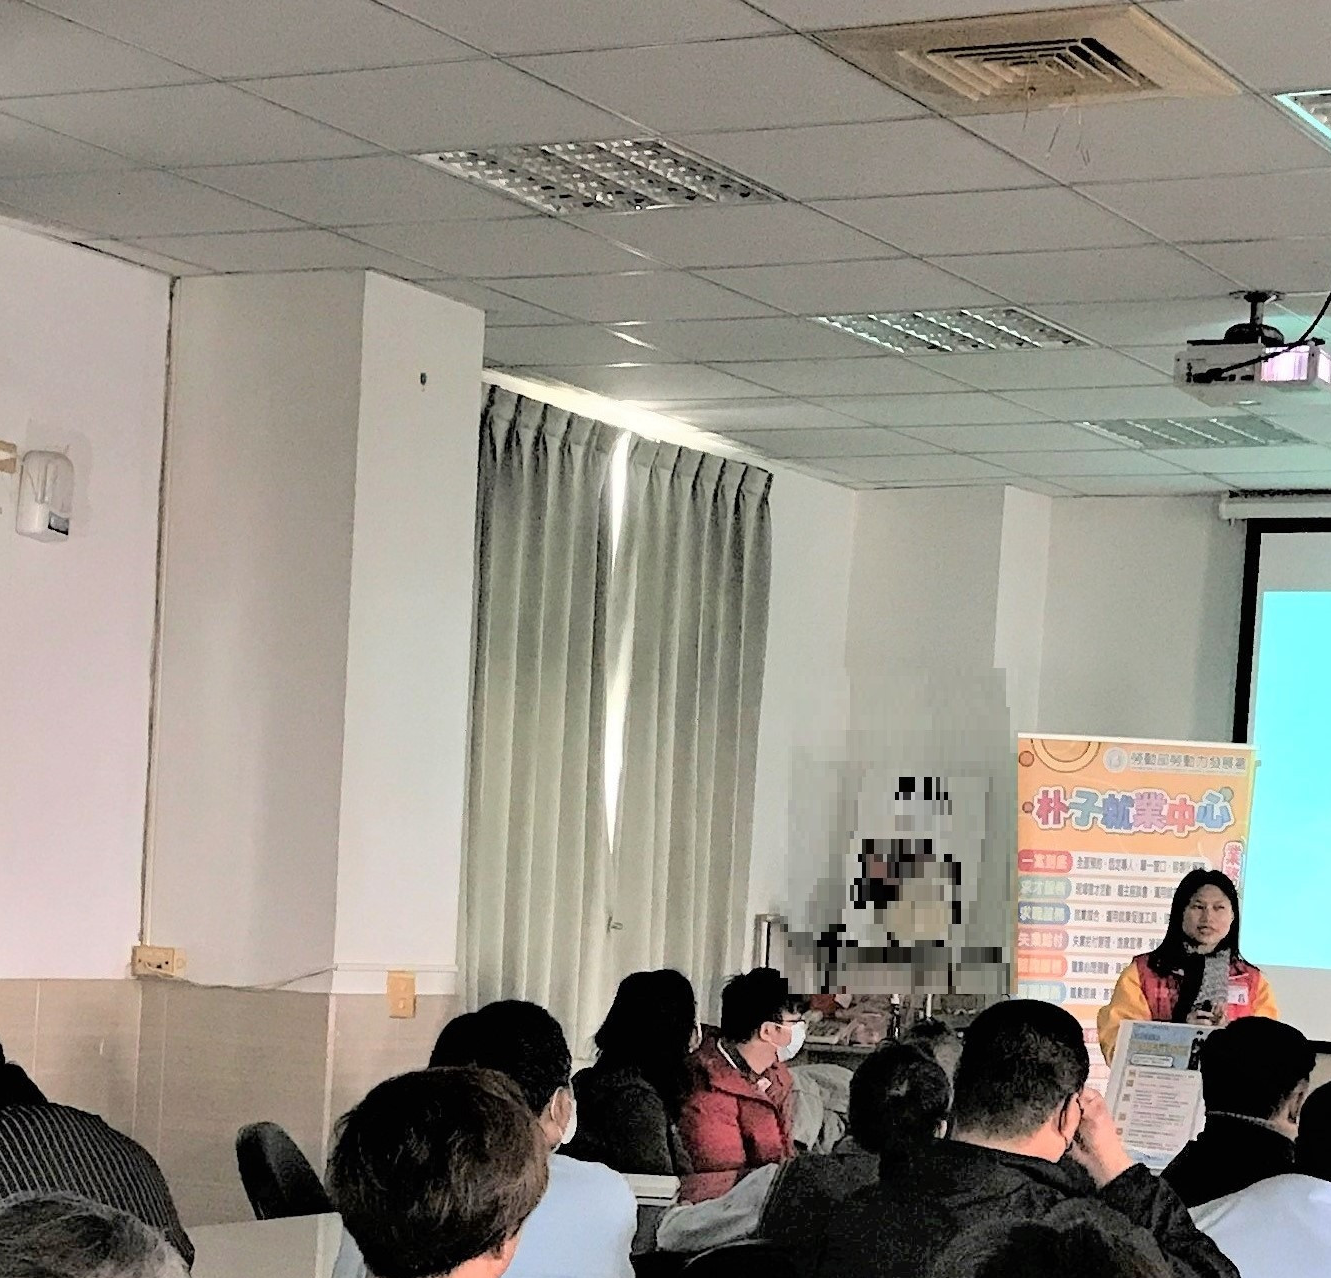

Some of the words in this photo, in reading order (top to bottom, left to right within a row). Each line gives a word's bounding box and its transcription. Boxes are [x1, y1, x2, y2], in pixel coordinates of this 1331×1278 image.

[1035, 789, 1232, 834] 朴子就業中心
